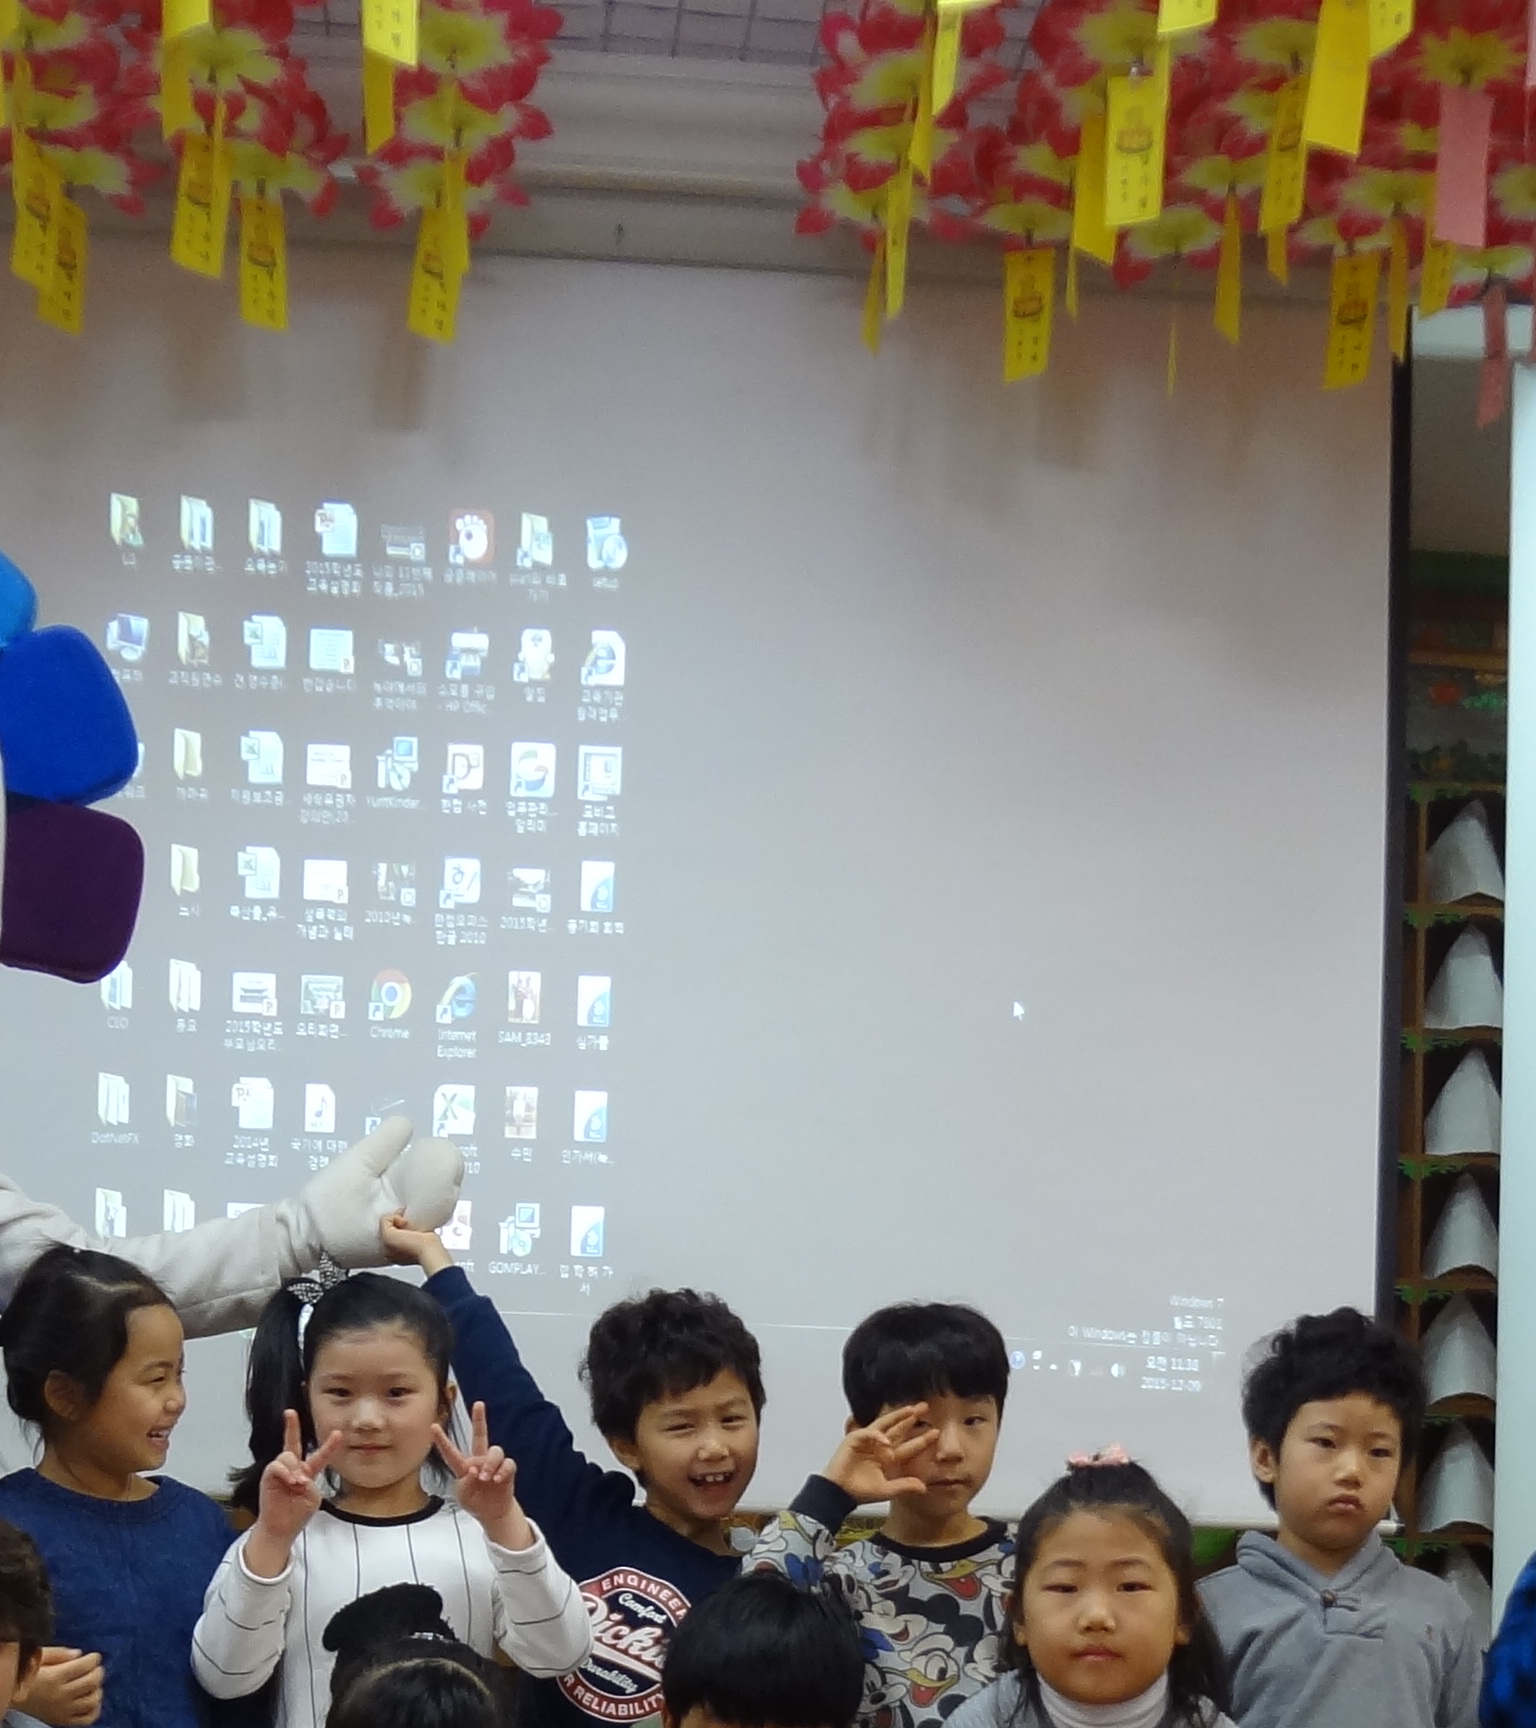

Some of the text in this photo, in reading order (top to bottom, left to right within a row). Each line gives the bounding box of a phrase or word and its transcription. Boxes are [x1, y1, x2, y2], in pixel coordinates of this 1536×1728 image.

[370, 1025, 411, 1039] Chrome
[438, 1028, 477, 1042] Internet
[437, 1045, 477, 1061] Explorer
[618, 1592, 668, 1625] Comfort
